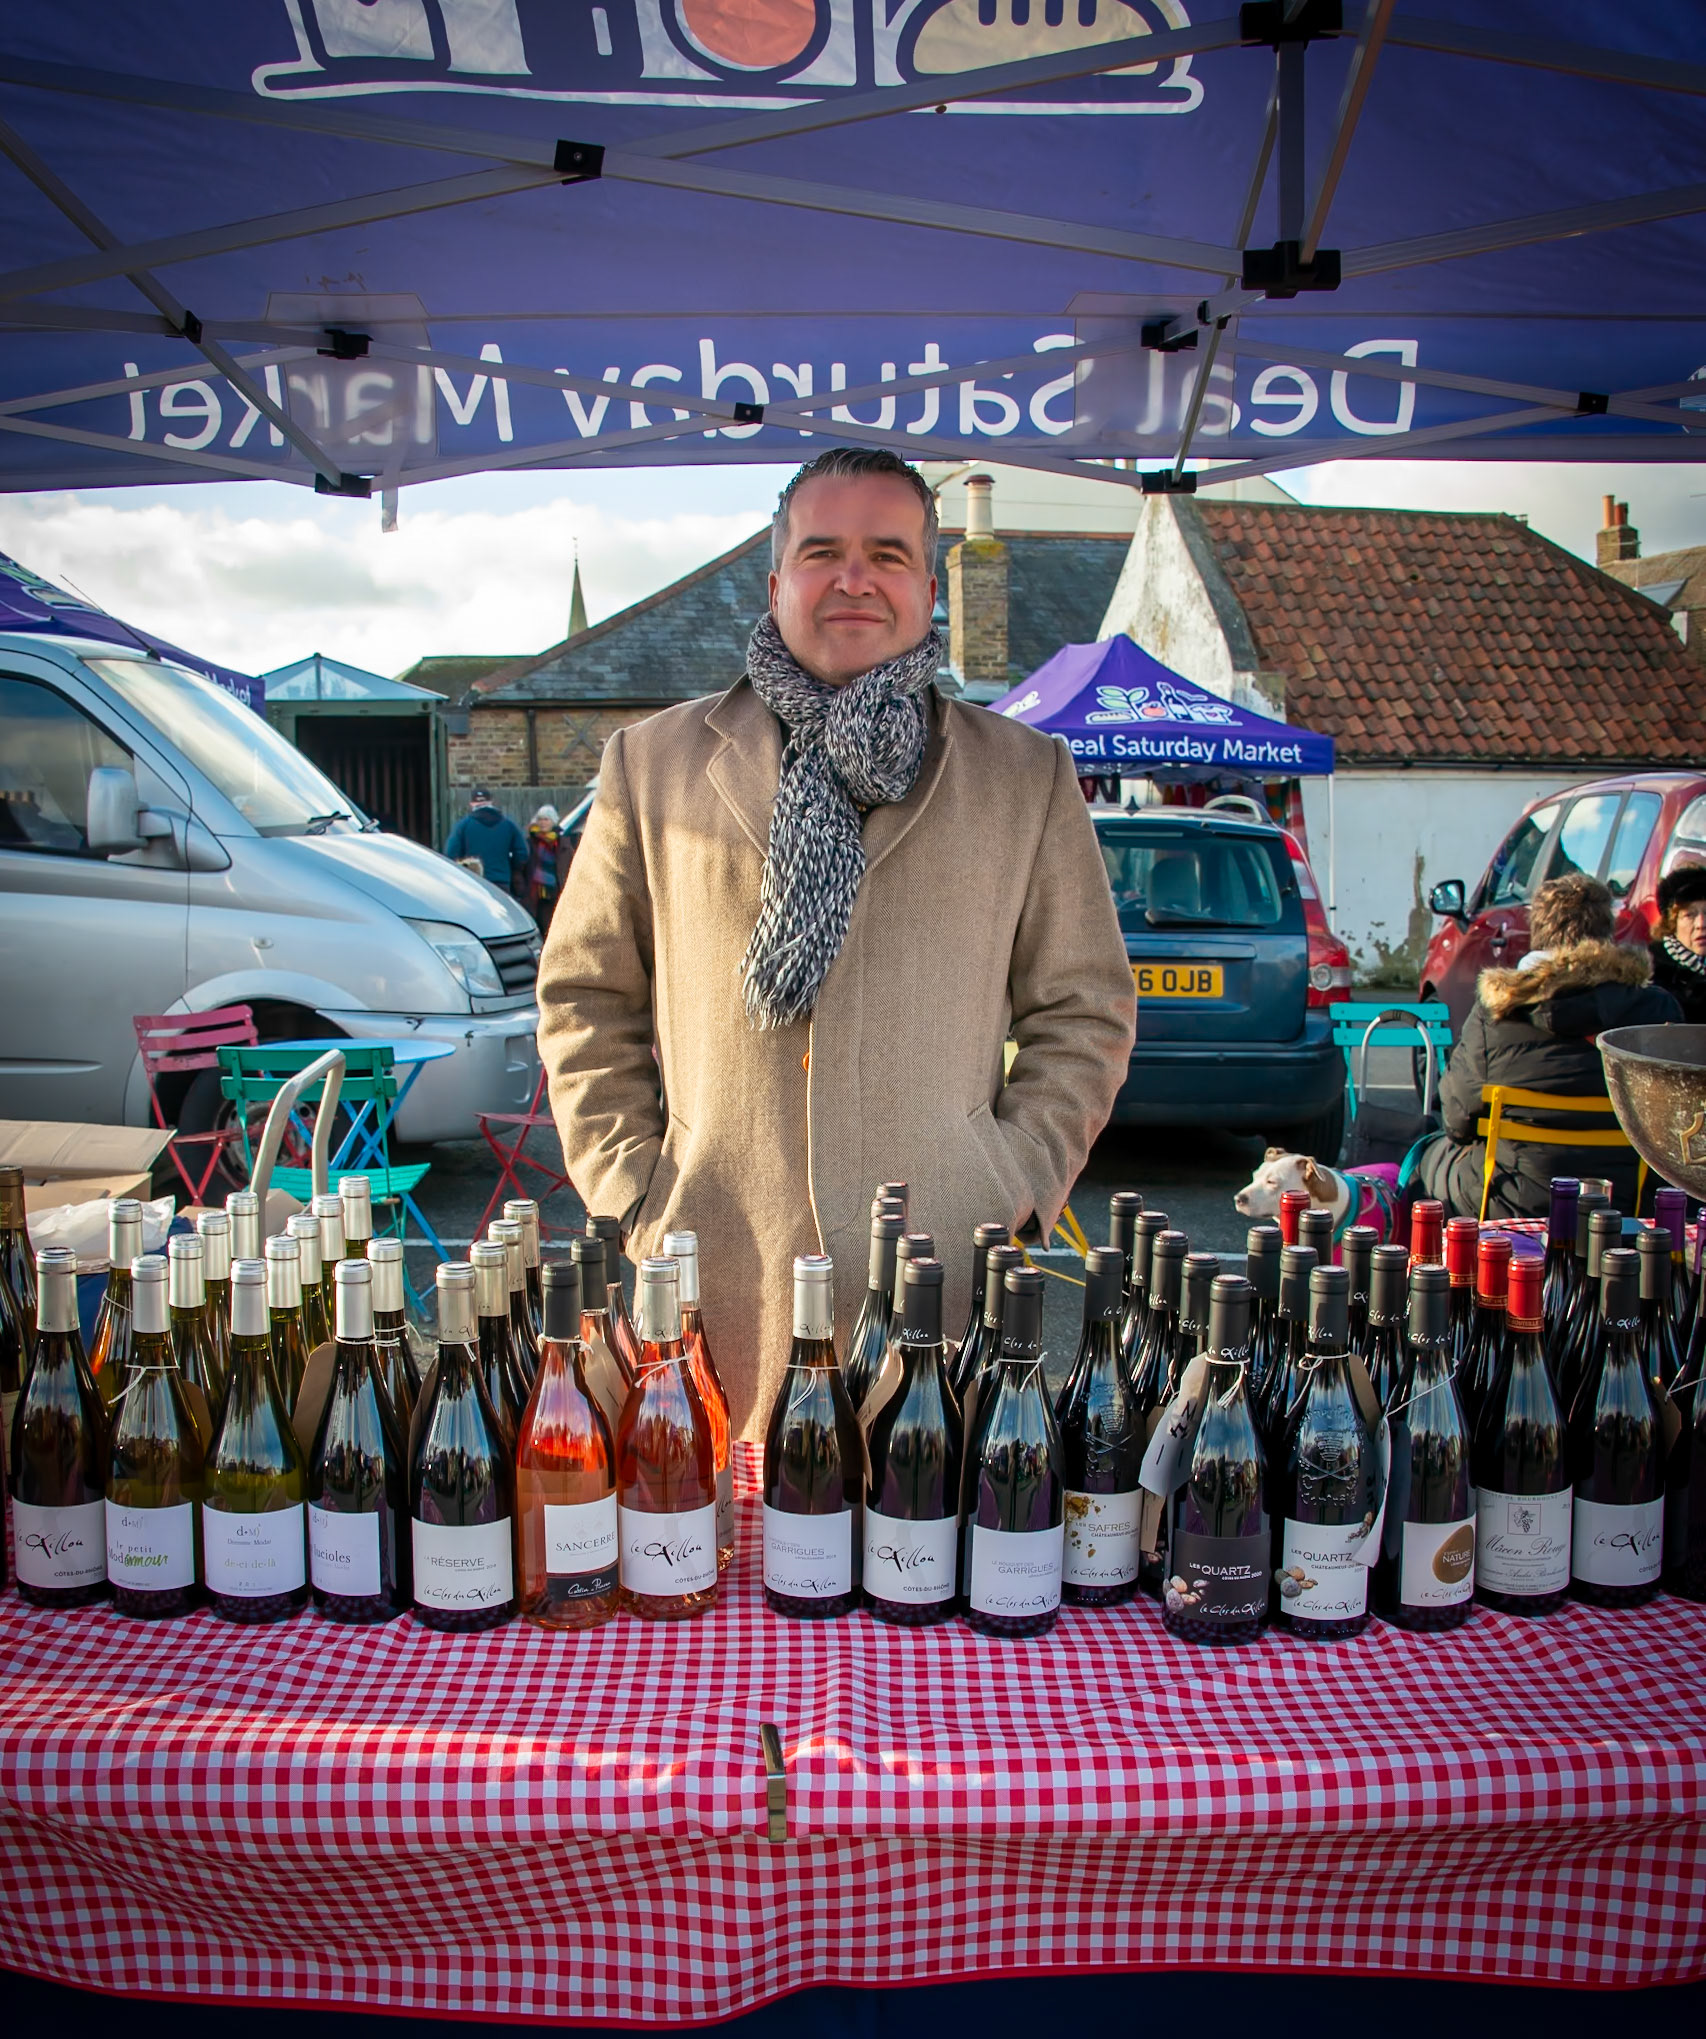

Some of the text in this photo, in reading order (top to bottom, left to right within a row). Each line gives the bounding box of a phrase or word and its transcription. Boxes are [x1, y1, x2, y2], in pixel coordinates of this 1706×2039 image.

[1112, 734, 1217, 763] Saturday
[1222, 738, 1303, 763] Market
[1132, 968, 1212, 993] 6 OJB
[1088, 1521, 1132, 1533] SAFRES
[555, 1531, 616, 1552] SANCERRE
[771, 1542, 826, 1557] GARRIGUES
[1290, 1548, 1353, 1563] LES QUARTZ
[1442, 1549, 1472, 1564] NATURE
[431, 1556, 485, 1568] RÉSERVE
[998, 1561, 1055, 1576] GARRIGUES
[1189, 1562, 1252, 1577] LES QUARTZ
